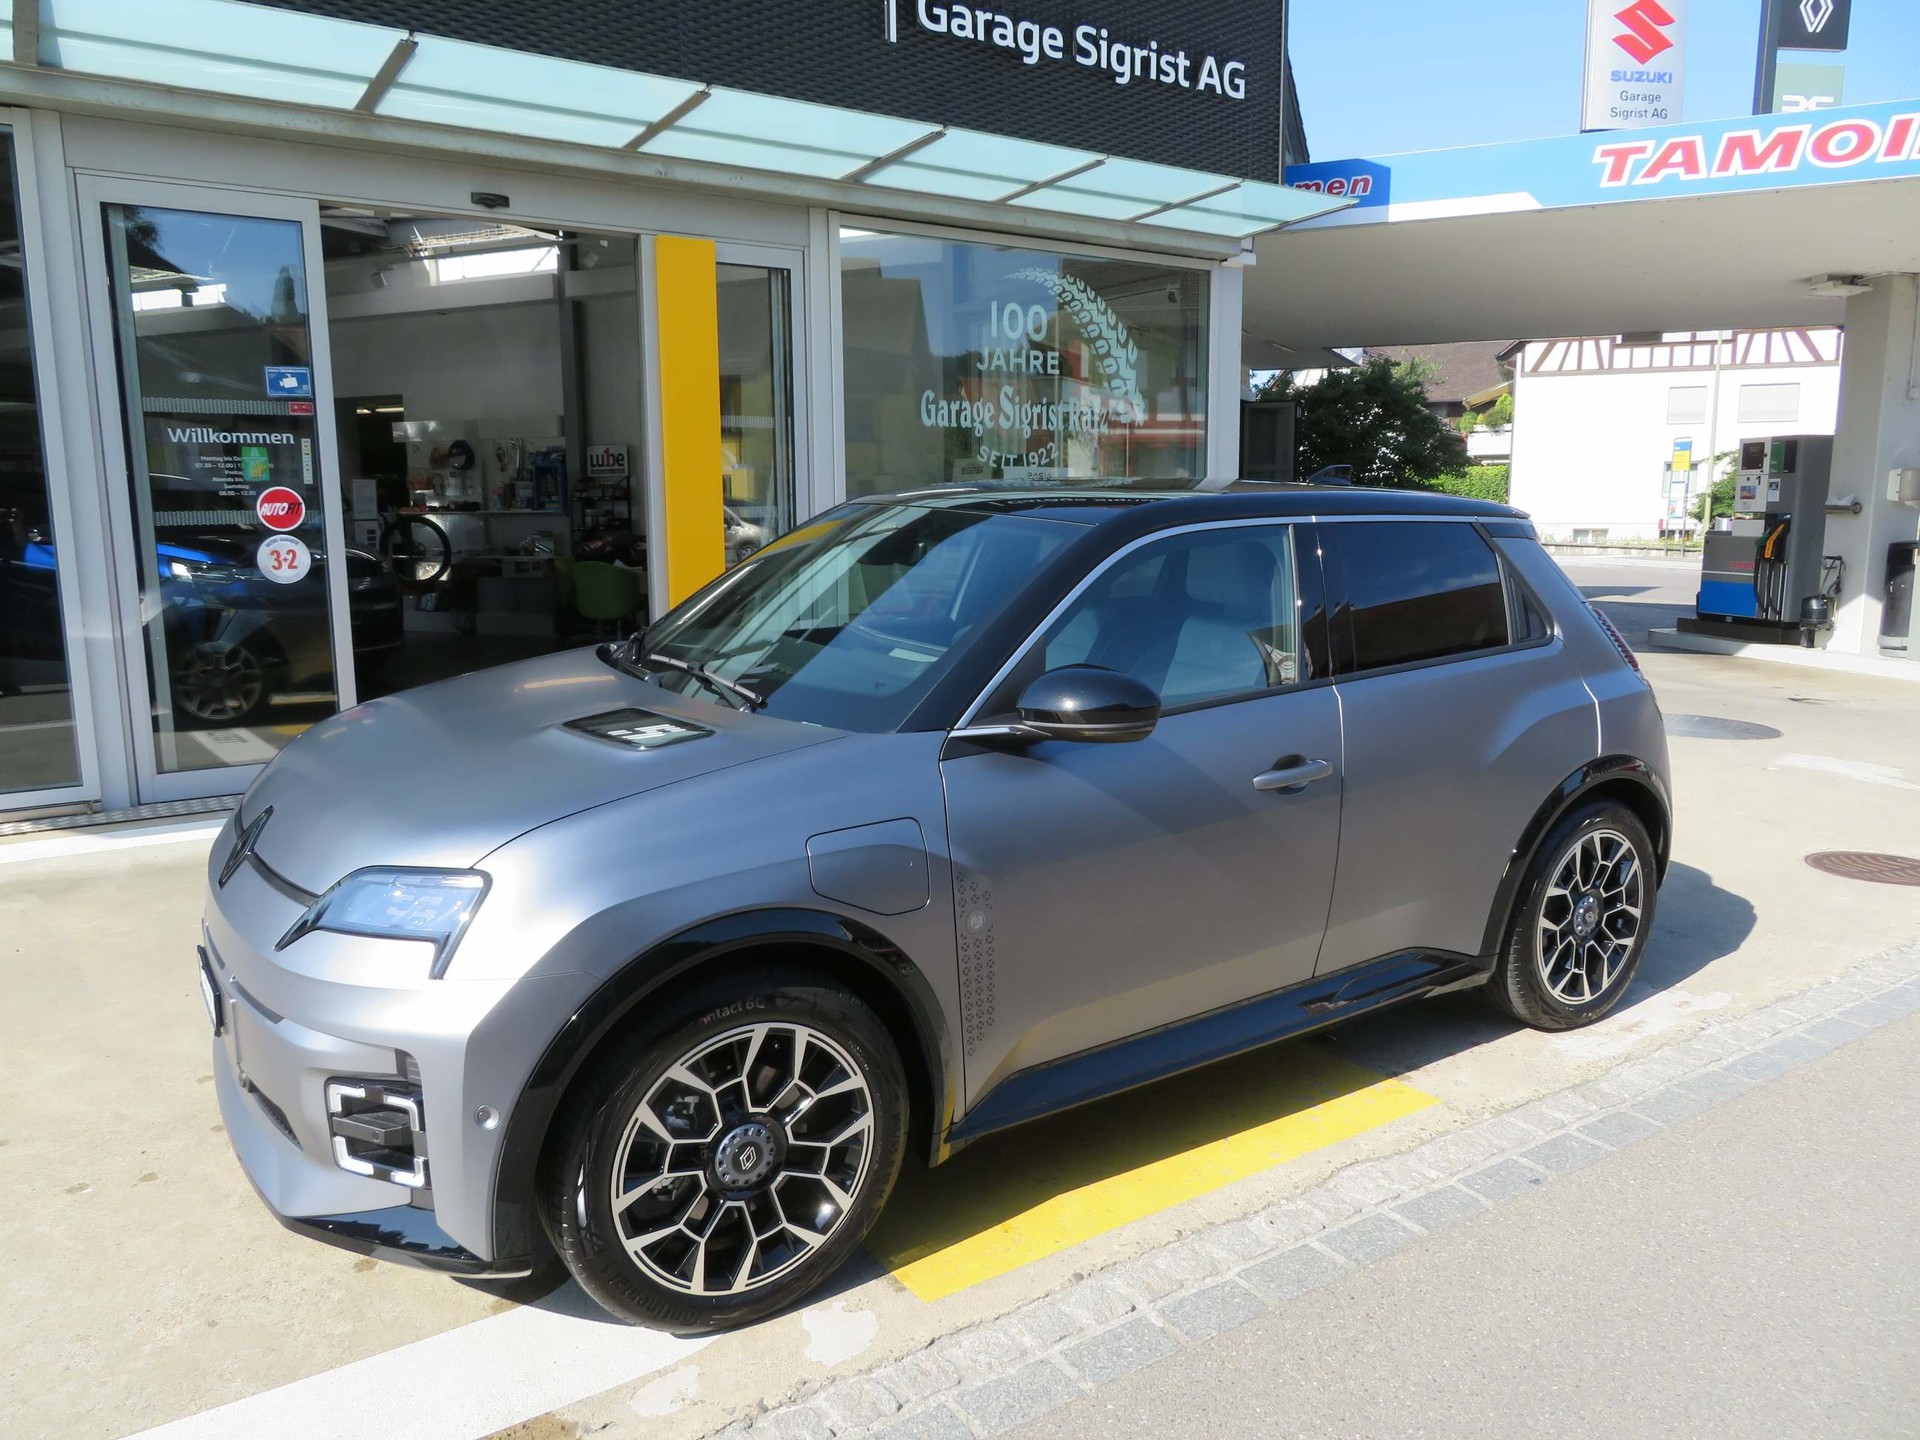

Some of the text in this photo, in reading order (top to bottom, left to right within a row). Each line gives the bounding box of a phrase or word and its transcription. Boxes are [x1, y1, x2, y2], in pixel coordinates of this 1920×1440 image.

[918, 0, 1246, 99] Garage Sigrist AG
[1610, 70, 1672, 84] SUZUKI
[1620, 90, 1661, 104] Garage
[1610, 107, 1668, 120] Sigrist AG
[1592, 112, 1920, 188] TAMOI
[990, 301, 1048, 341] 100
[976, 347, 1060, 375] JAHRE
[920, 389, 995, 437] Garage
[998, 385, 1065, 438] Sigrist
[167, 428, 295, 444] Willkommen
[977, 442, 1059, 469] SEIT 1922
[1756, 476, 1761, 485] 1
